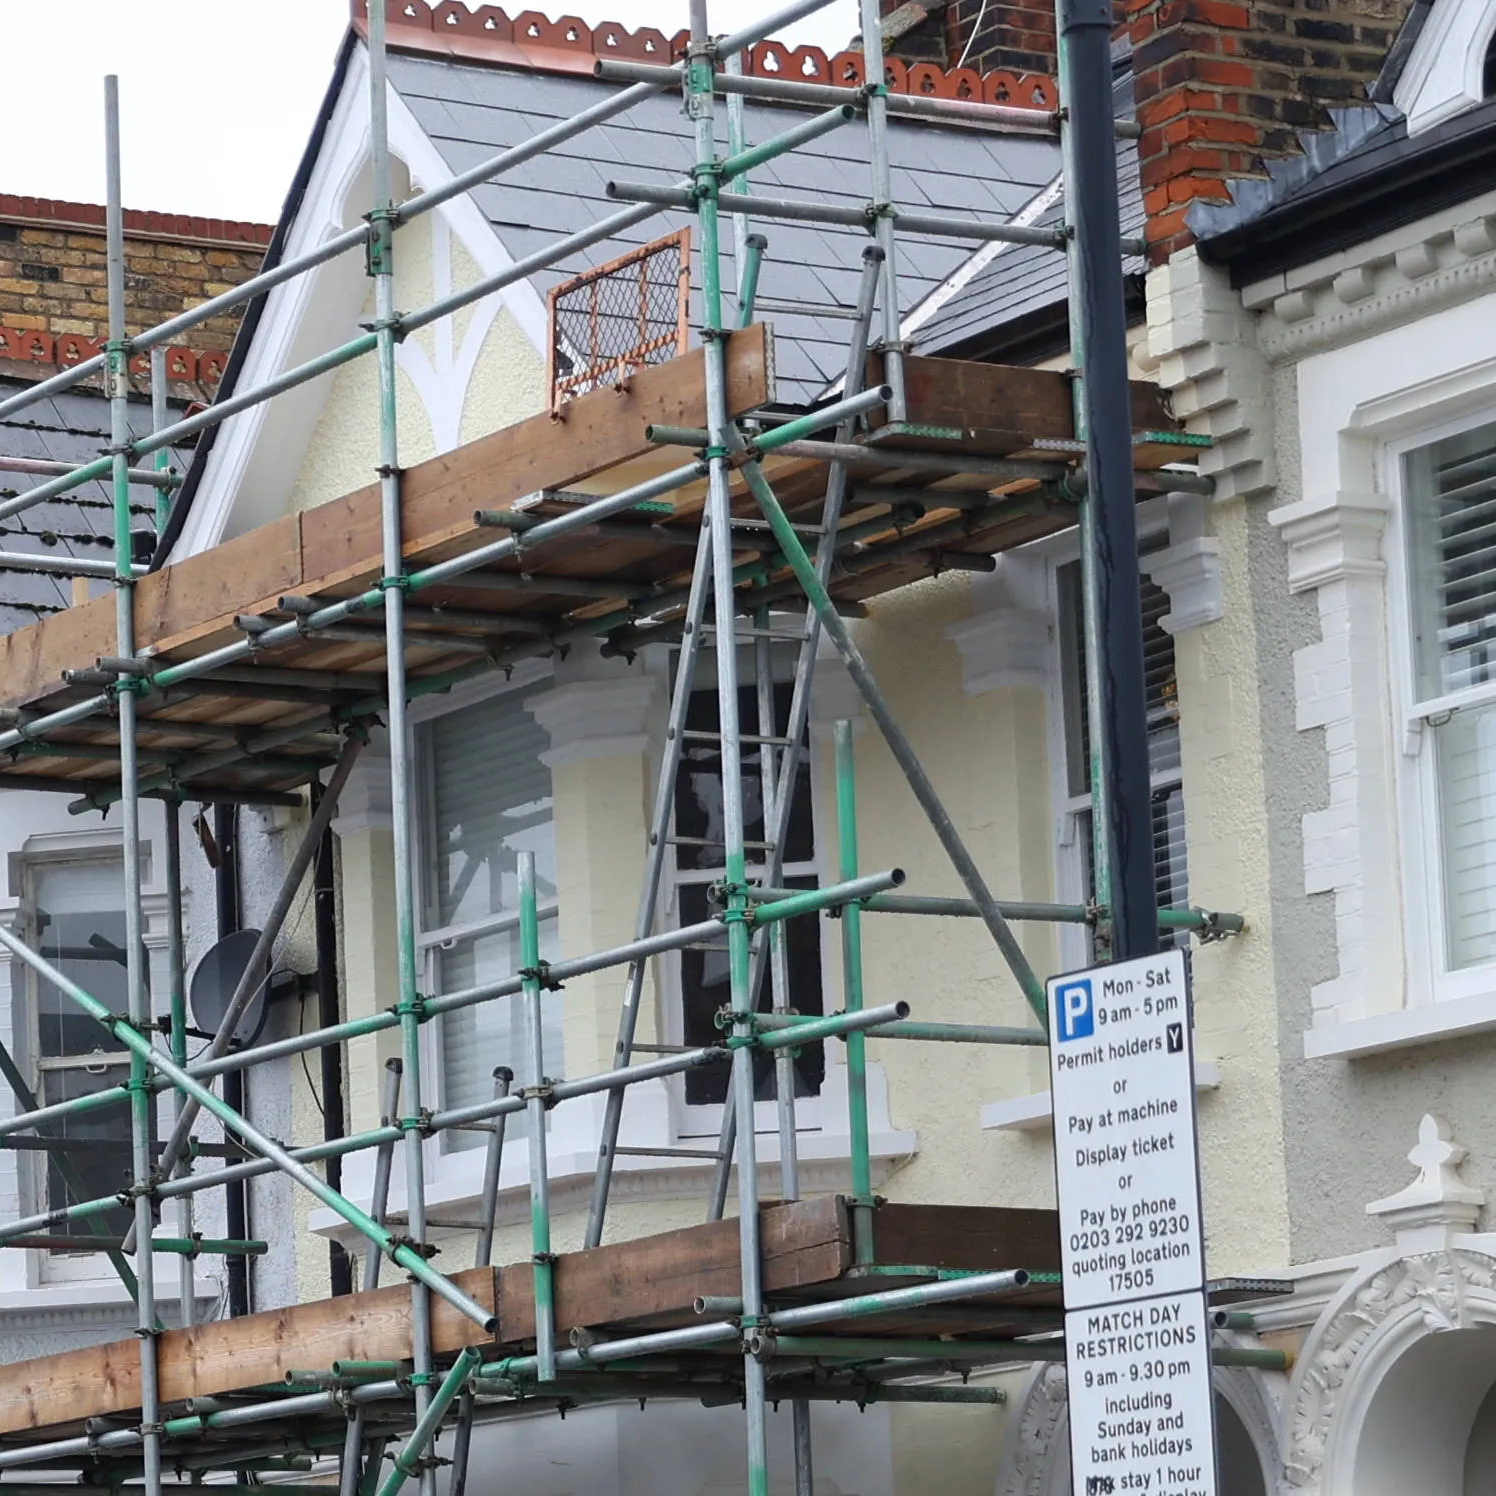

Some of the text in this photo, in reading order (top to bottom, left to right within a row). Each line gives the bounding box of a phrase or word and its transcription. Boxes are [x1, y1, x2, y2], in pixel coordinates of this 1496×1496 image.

[1103, 977, 1134, 998] Mon
[1145, 967, 1172, 988] Sat
[1098, 1005, 1107, 1025] 9
[1110, 1005, 1132, 1023] am
[1144, 998, 1153, 1015] 5
[1156, 993, 1178, 1017] pm
[1057, 1044, 1104, 1072] Permit
[1108, 1034, 1163, 1061] holders
[1113, 1077, 1128, 1094] or
[1068, 1097, 1178, 1134] Pay at machine
[1075, 1132, 1175, 1167] Display ticket
[1118, 1173, 1133, 1190] or
[1080, 1197, 1177, 1229] Pay by phone
[1070, 1215, 1190, 1252] 0203 292 9230
[1072, 1241, 1191, 1278] quoting location
[1109, 1267, 1155, 1292] 17505
[1087, 1303, 1181, 1336] MATCH DAY
[1076, 1326, 1197, 1360] RESTRICTIONS
[1084, 1370, 1094, 1388] 9
[1096, 1369, 1118, 1387] am
[1129, 1359, 1165, 1382] 9.30
[1168, 1358, 1191, 1381] pm
[1105, 1391, 1173, 1415] including
[1097, 1412, 1184, 1440] Sunday and
[1091, 1436, 1192, 1463] bank holidays
[1121, 1467, 1151, 1490] stay
[1156, 1467, 1162, 1484] 1
[1168, 1465, 1201, 1483] hour
